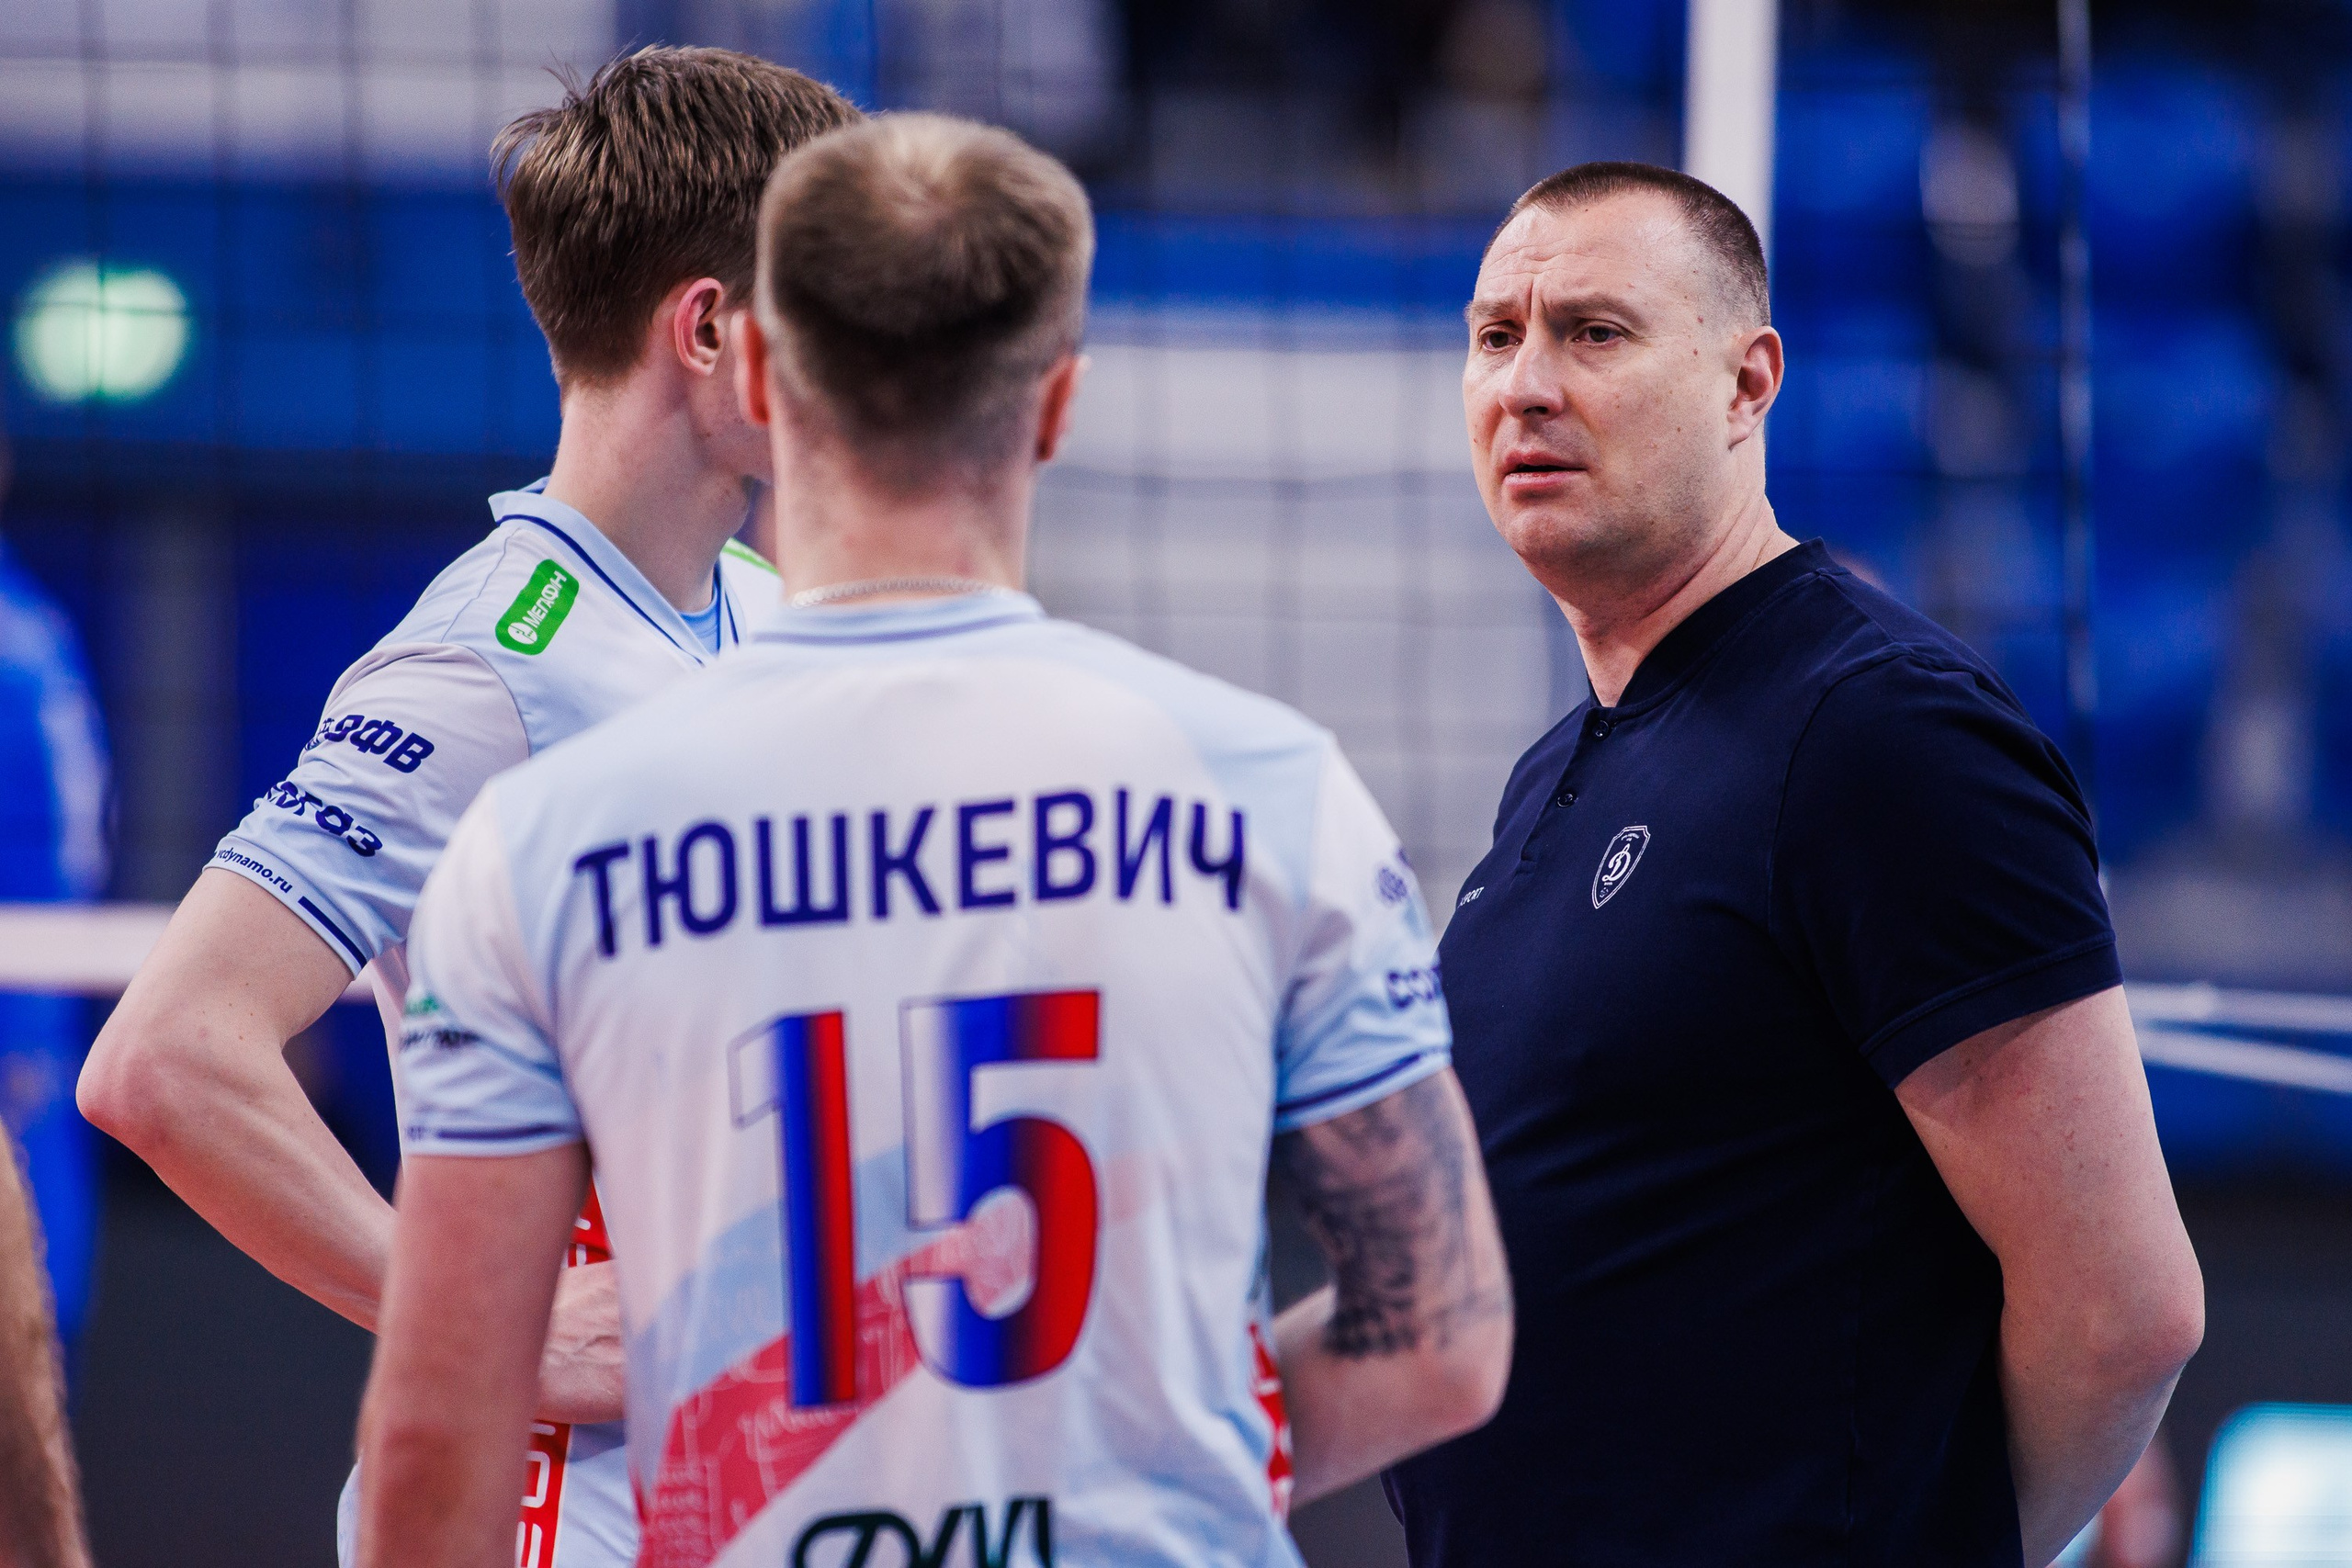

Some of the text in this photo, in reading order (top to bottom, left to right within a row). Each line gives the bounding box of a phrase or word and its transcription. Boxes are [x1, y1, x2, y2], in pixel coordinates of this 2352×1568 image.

[522, 570, 568, 629] МЕГАФН
[573, 787, 1246, 957] ТЮШКЕВИЧ
[728, 987, 1100, 1412] 15
